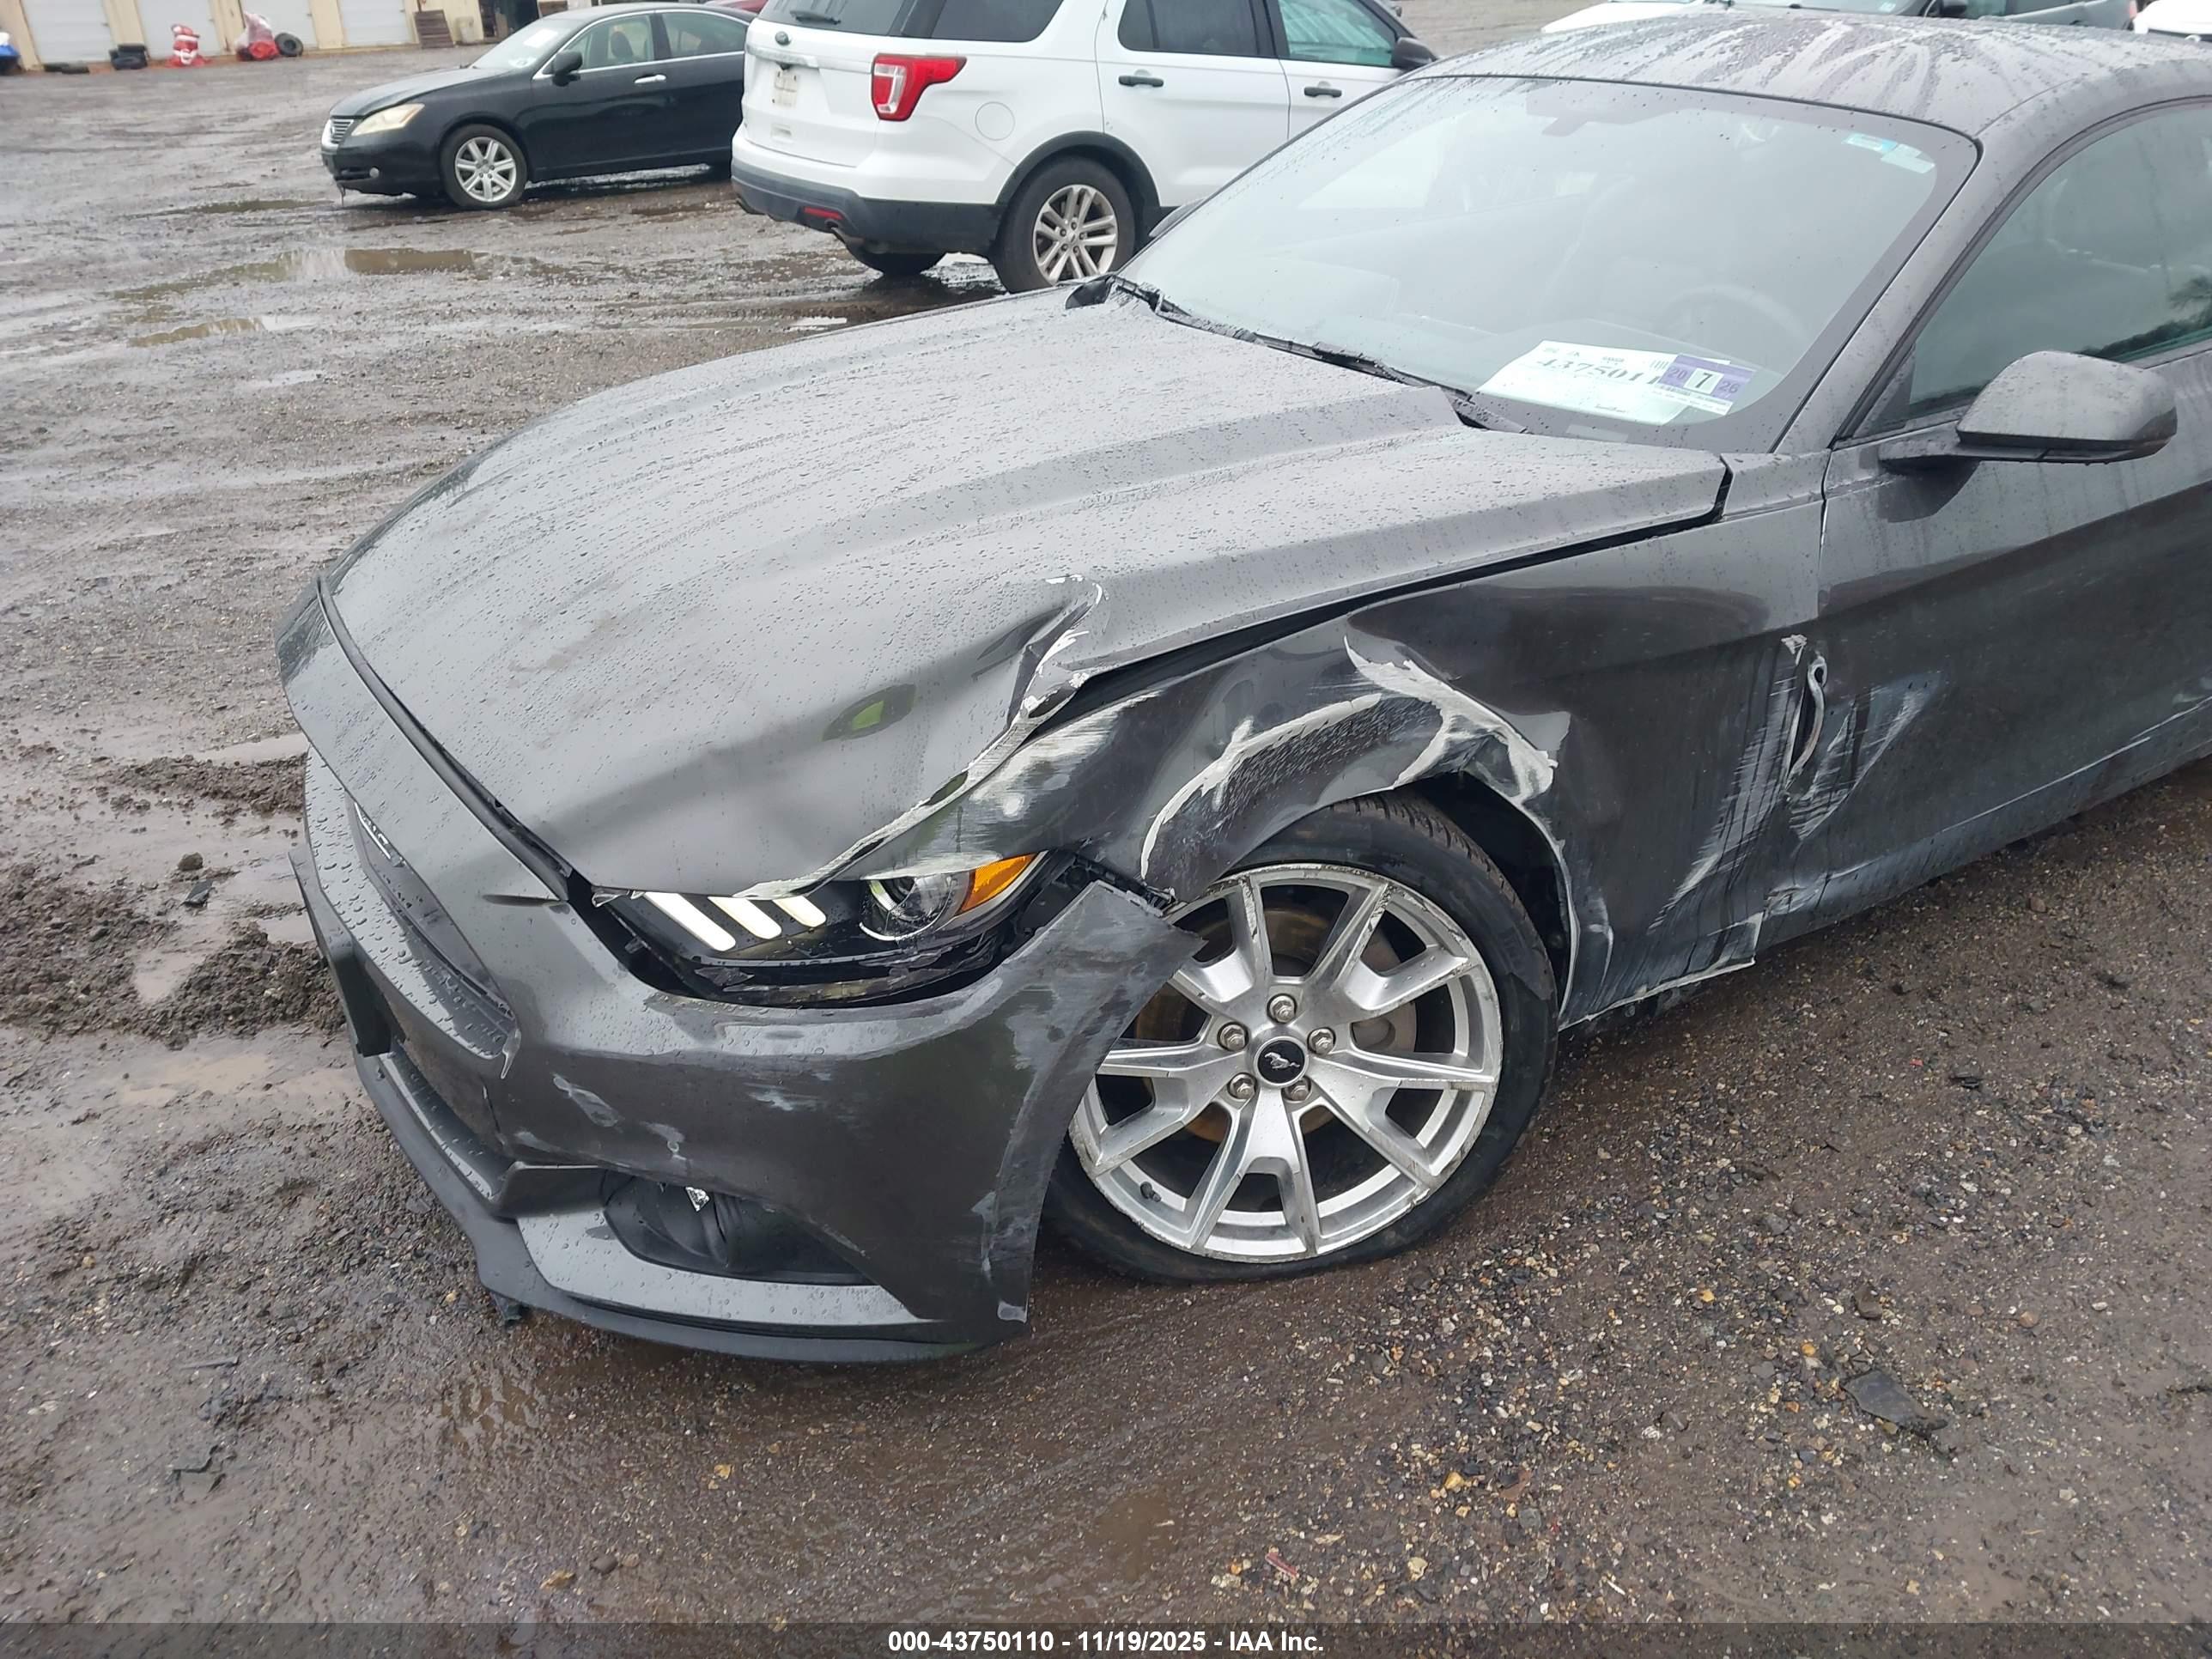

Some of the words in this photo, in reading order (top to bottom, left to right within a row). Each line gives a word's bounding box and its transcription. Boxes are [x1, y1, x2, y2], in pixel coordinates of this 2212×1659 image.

[1668, 366, 1688, 380] 20
[1694, 372, 1714, 388] 7
[1718, 381, 1740, 393] 26
